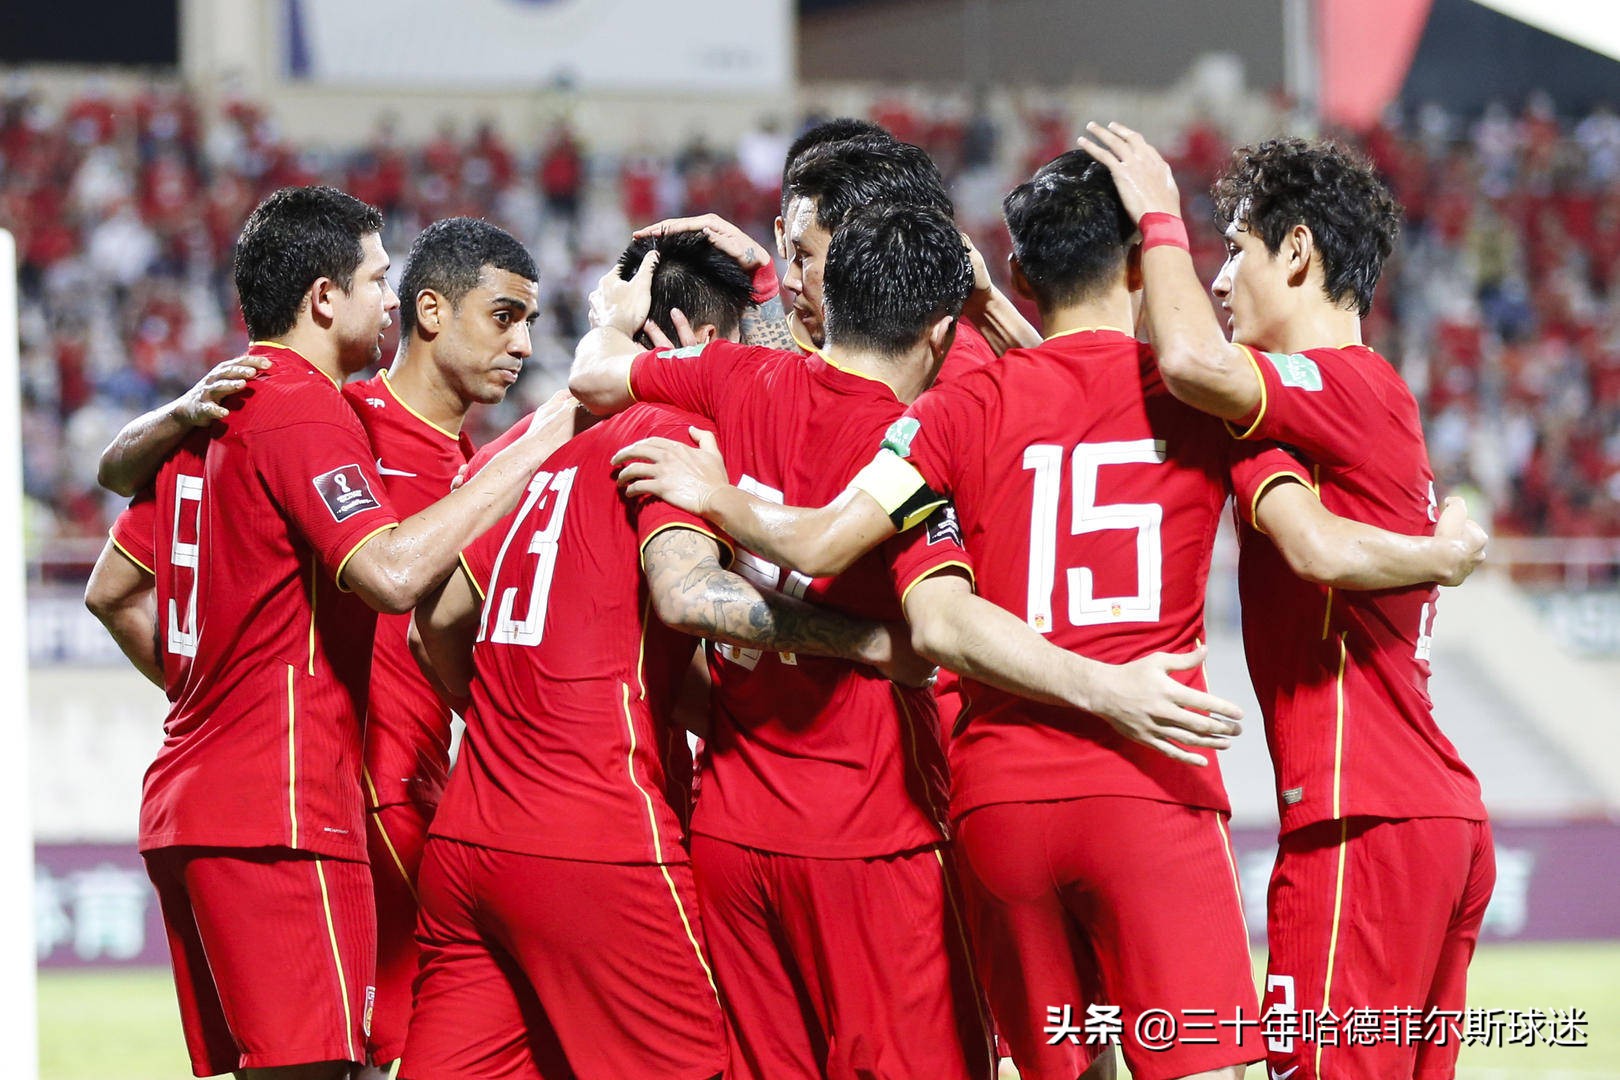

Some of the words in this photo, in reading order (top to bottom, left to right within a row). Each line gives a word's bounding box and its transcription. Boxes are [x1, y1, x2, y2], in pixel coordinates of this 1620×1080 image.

[168, 474, 204, 658] 9
[474, 466, 579, 647] 13
[1023, 438, 1167, 634] 15
